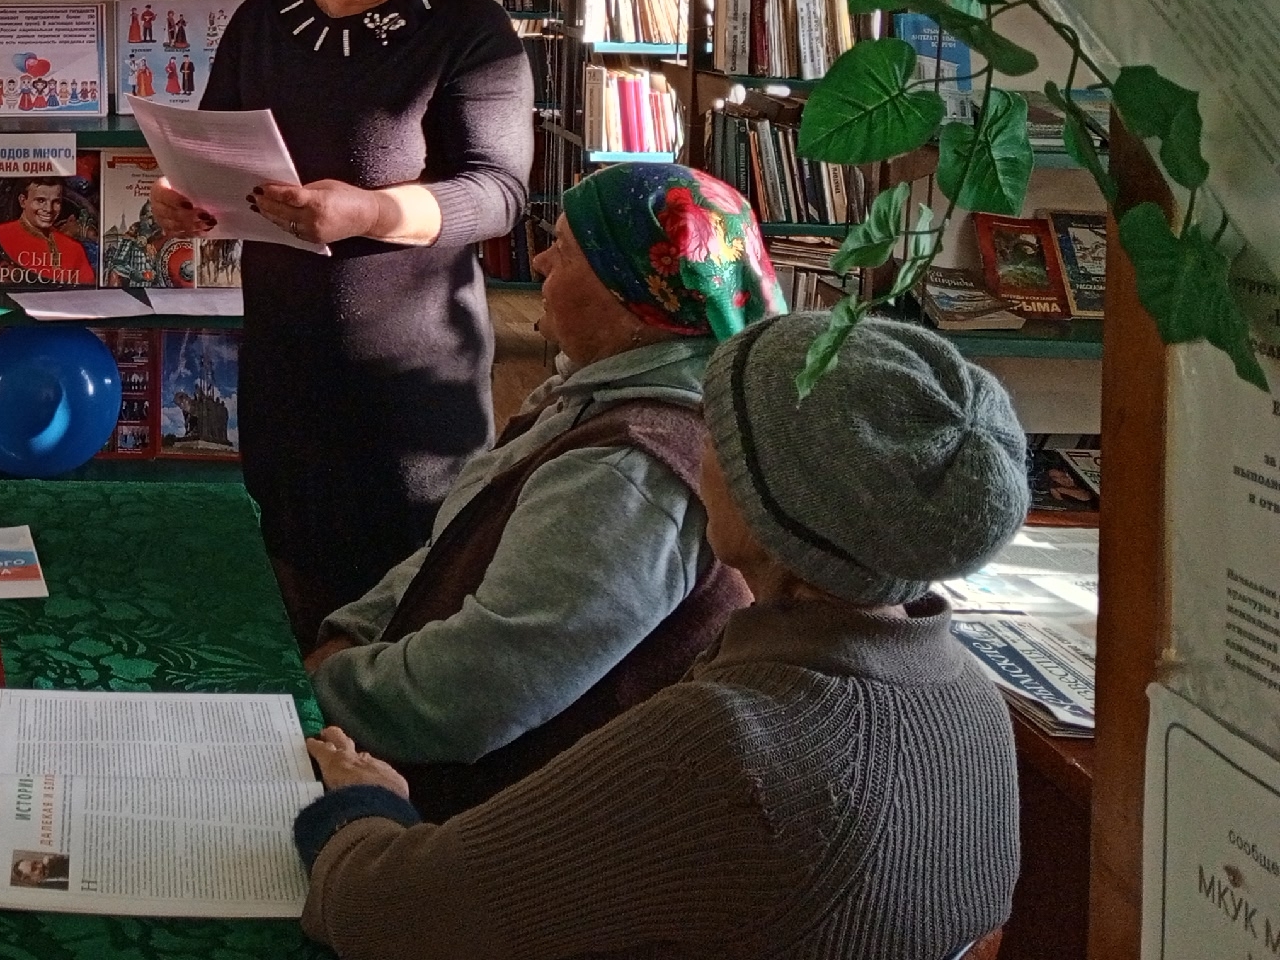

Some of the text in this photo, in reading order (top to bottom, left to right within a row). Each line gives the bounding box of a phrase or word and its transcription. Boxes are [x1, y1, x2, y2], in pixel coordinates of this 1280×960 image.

[33, 148, 75, 160] МНОГО,
[23, 161, 53, 174] ОДНА
[18, 251, 63, 267] СЫН
[1008, 300, 1062, 313] РЫМА
[1198, 863, 1258, 939] МКУК
